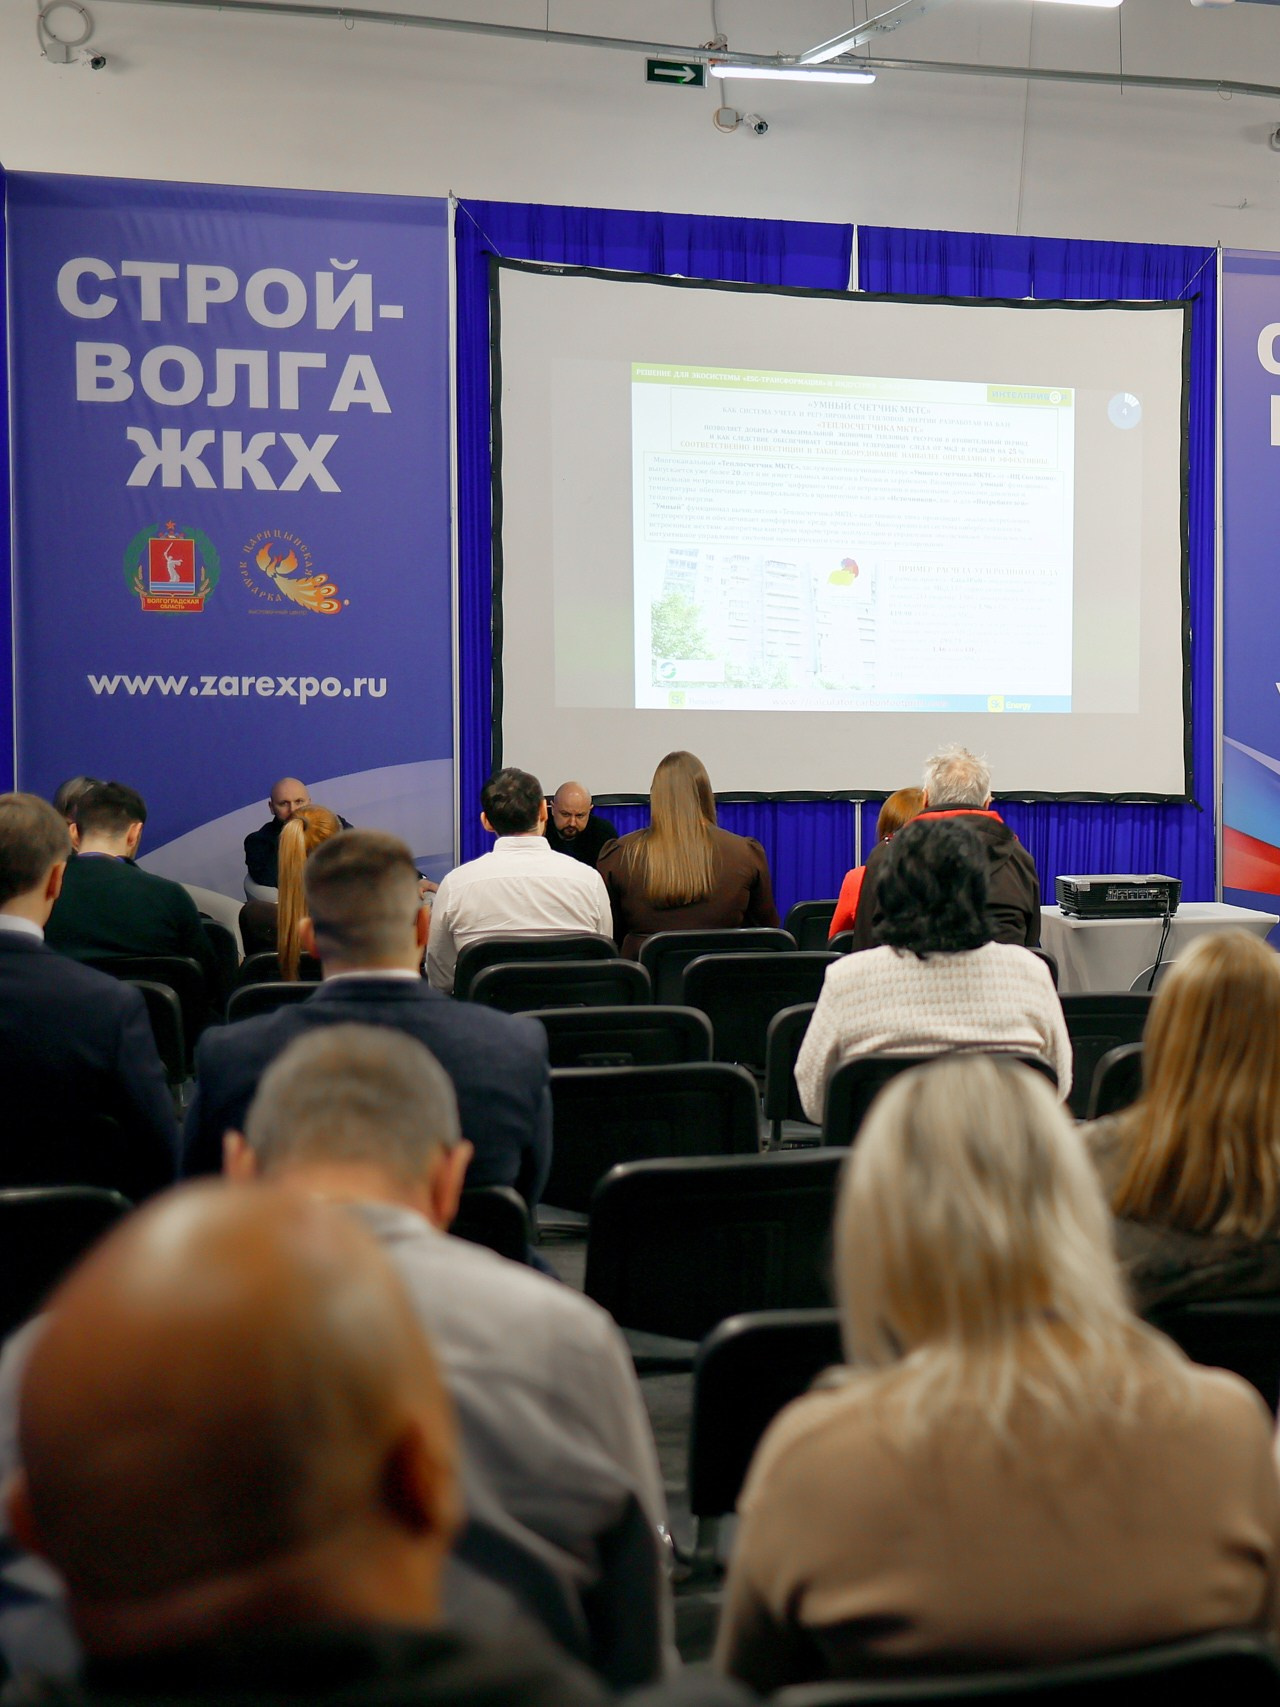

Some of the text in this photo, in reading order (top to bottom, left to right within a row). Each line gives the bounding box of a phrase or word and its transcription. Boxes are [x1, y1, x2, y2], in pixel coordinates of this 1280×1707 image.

[56, 257, 404, 333] СТРОЙ-
[75, 341, 392, 414] ВОЛГА
[636, 369, 672, 377] РЕШЕНИЕ
[691, 372, 741, 381] ЭКОСИСТЕМЫ
[740, 408, 771, 416] СИСТЕМА
[808, 399, 931, 415] «УМНЫЙ СЧЕТЧИК МКТС»
[704, 425, 741, 433] ПОЗВОЛЯЕТ
[817, 421, 923, 434] «ТЕПЛОСЧЕТЧИКА МКТС»
[126, 427, 342, 493] ЖКХ
[243, 529, 315, 577] ЦАРИЦЫНСКАЯ
[87, 671, 388, 705] www.zarexpo.ru
